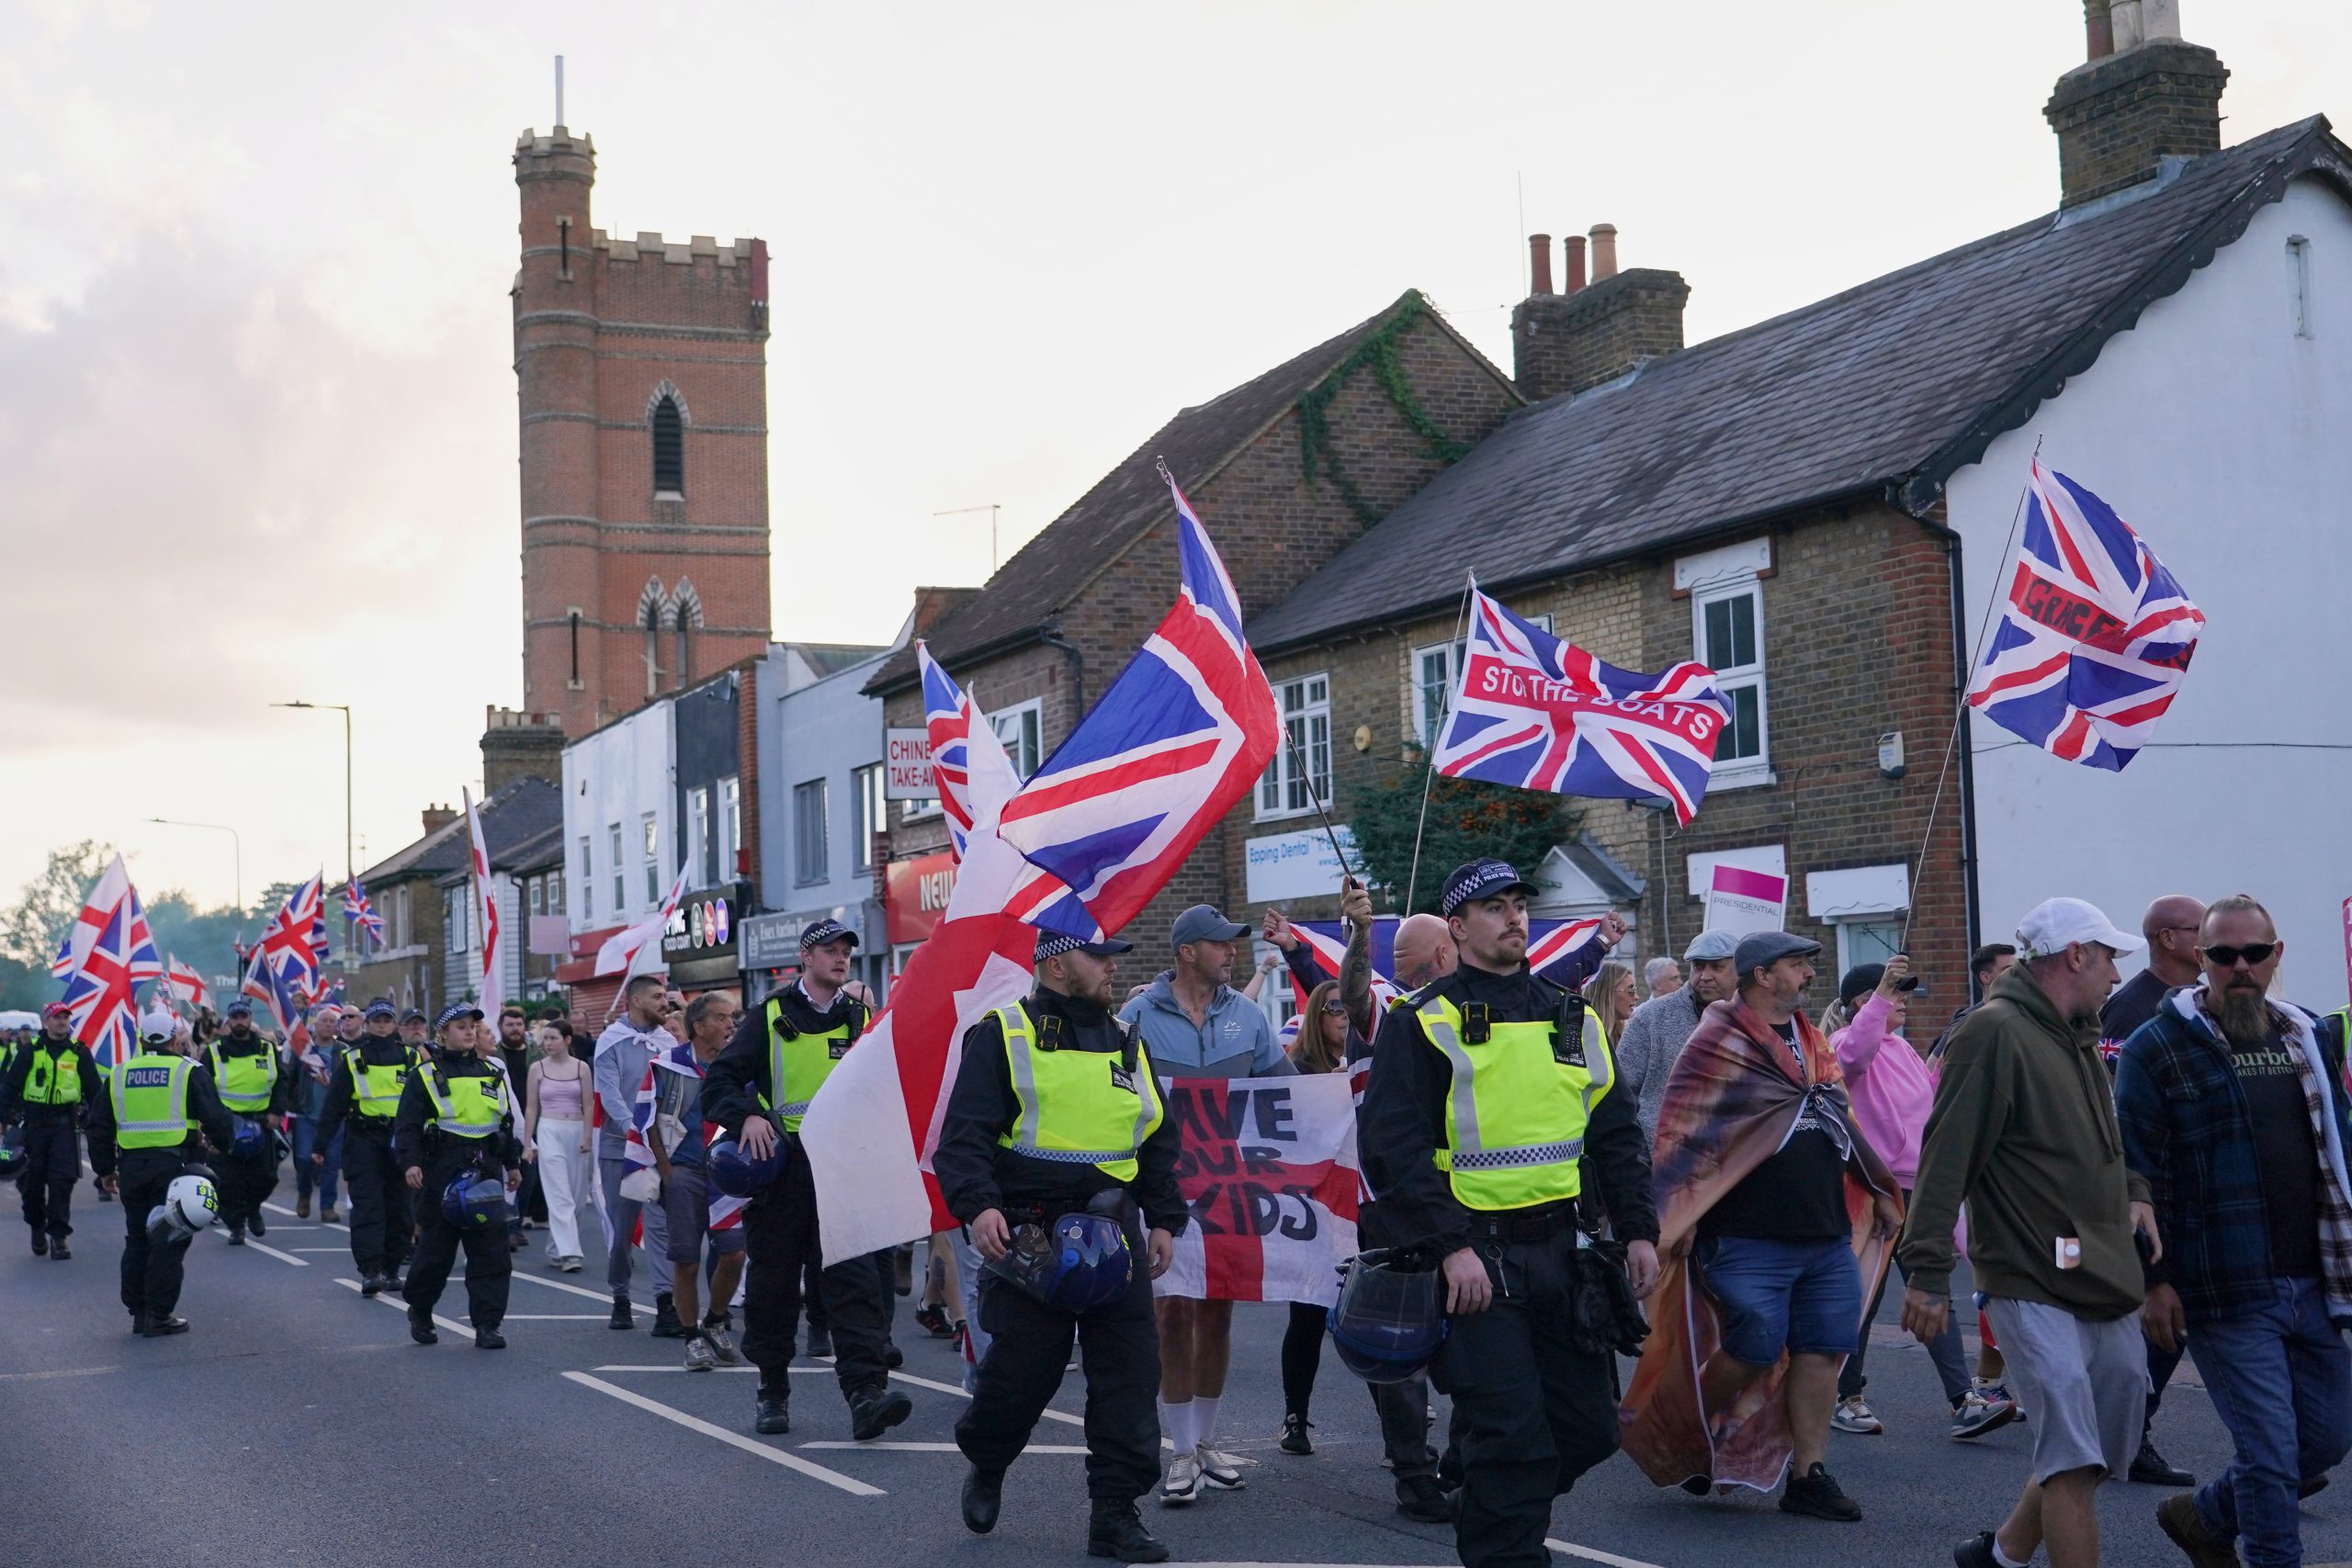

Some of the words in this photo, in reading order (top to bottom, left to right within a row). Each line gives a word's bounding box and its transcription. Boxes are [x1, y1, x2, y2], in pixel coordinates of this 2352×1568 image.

[890, 740, 932, 761] CHINE
[1250, 846, 1279, 865] Epping
[1281, 840, 1309, 859] Dental
[1713, 897, 1779, 917] PRESIDENTIAL
[2231, 1046, 2292, 1067] ourbo
[128, 1070, 168, 1085] POLICE
[2237, 1066, 2257, 1077] AKES
[1169, 1087, 1298, 1142] AVE
[1189, 1180, 1317, 1241] KIDS
